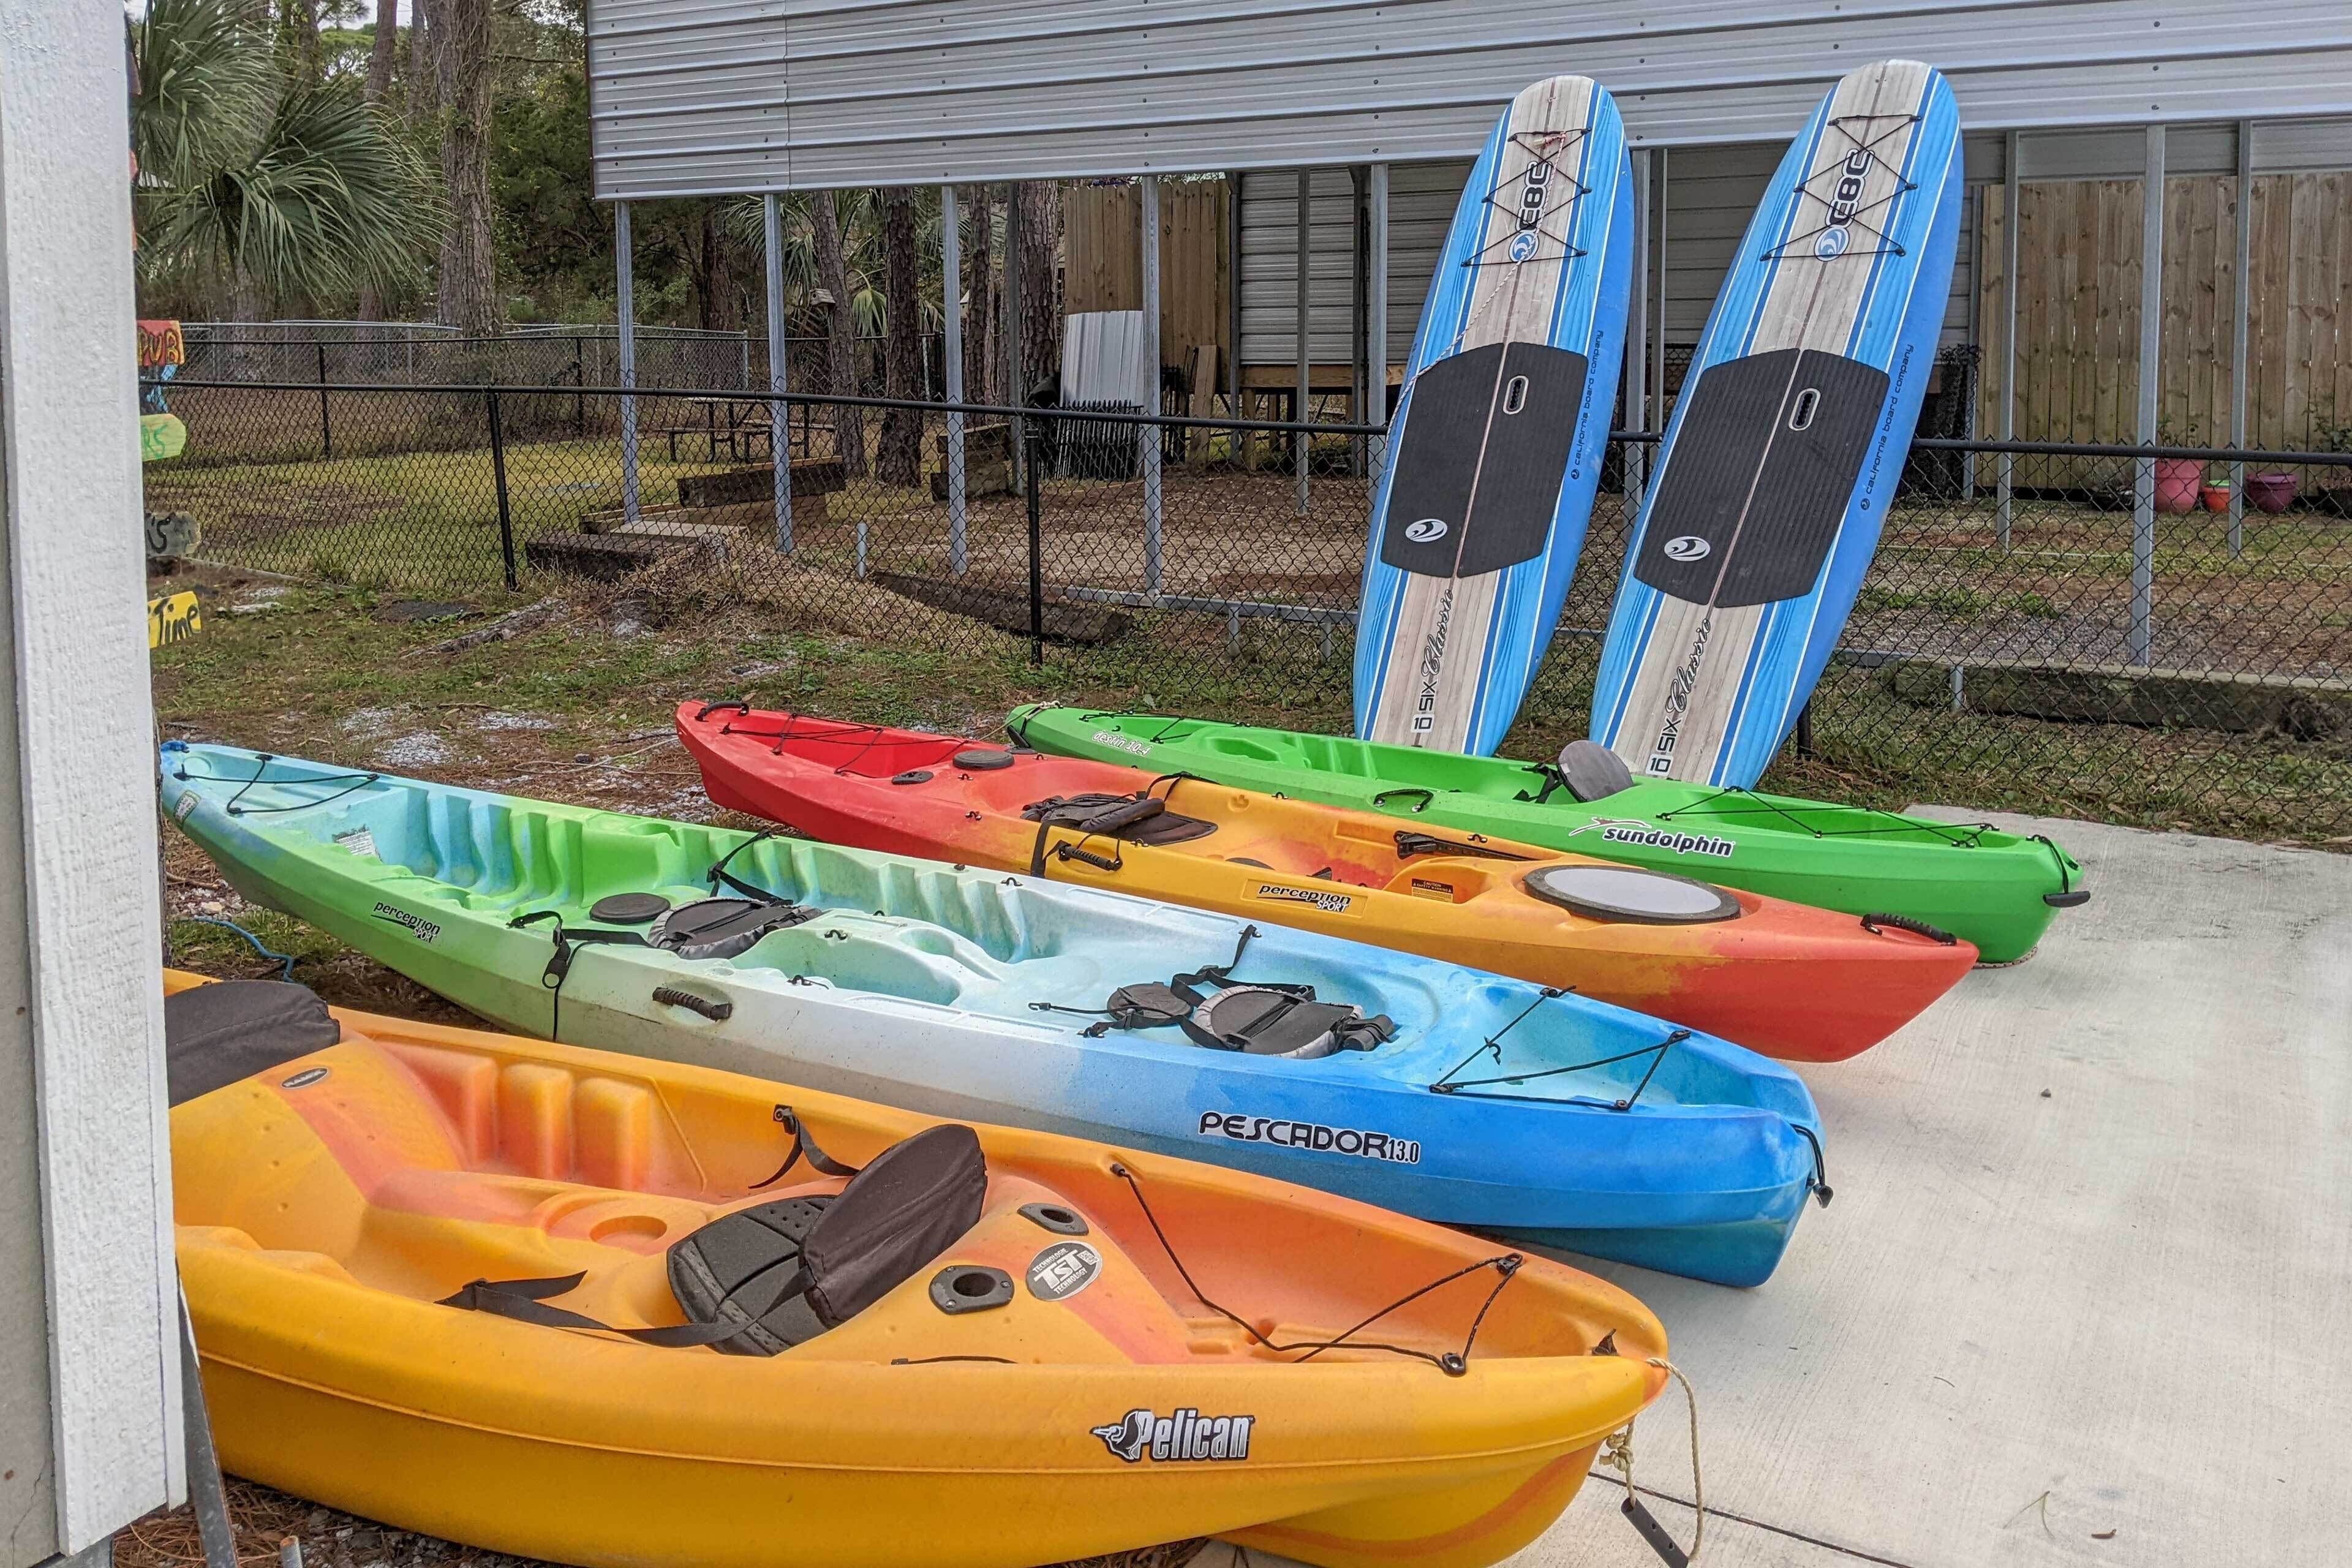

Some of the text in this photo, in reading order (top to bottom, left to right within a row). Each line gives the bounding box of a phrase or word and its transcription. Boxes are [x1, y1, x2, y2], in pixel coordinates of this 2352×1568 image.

[1515, 160, 1553, 232] CBC
[1825, 148, 1875, 227] CBC
[1575, 330, 1604, 466] california board company
[1866, 344, 1913, 494] california board company
[1414, 589, 1453, 729] 10 SIX Classic
[1651, 618, 1711, 773] 10 SIX Classic
[1093, 729, 1125, 749] destin
[1603, 827, 1733, 856] sundolphin
[1259, 885, 1351, 906] perception
[1316, 900, 1348, 913] SPORT
[373, 901, 441, 935] perception
[412, 927, 437, 943] SPORT
[1199, 1111, 1420, 1163] PESCADOR 13.0
[1032, 1248, 1068, 1273] TECHNOLOGIE
[1054, 1267, 1088, 1294] TECHNOLOGY
[1131, 1409, 1250, 1460] Pelican
